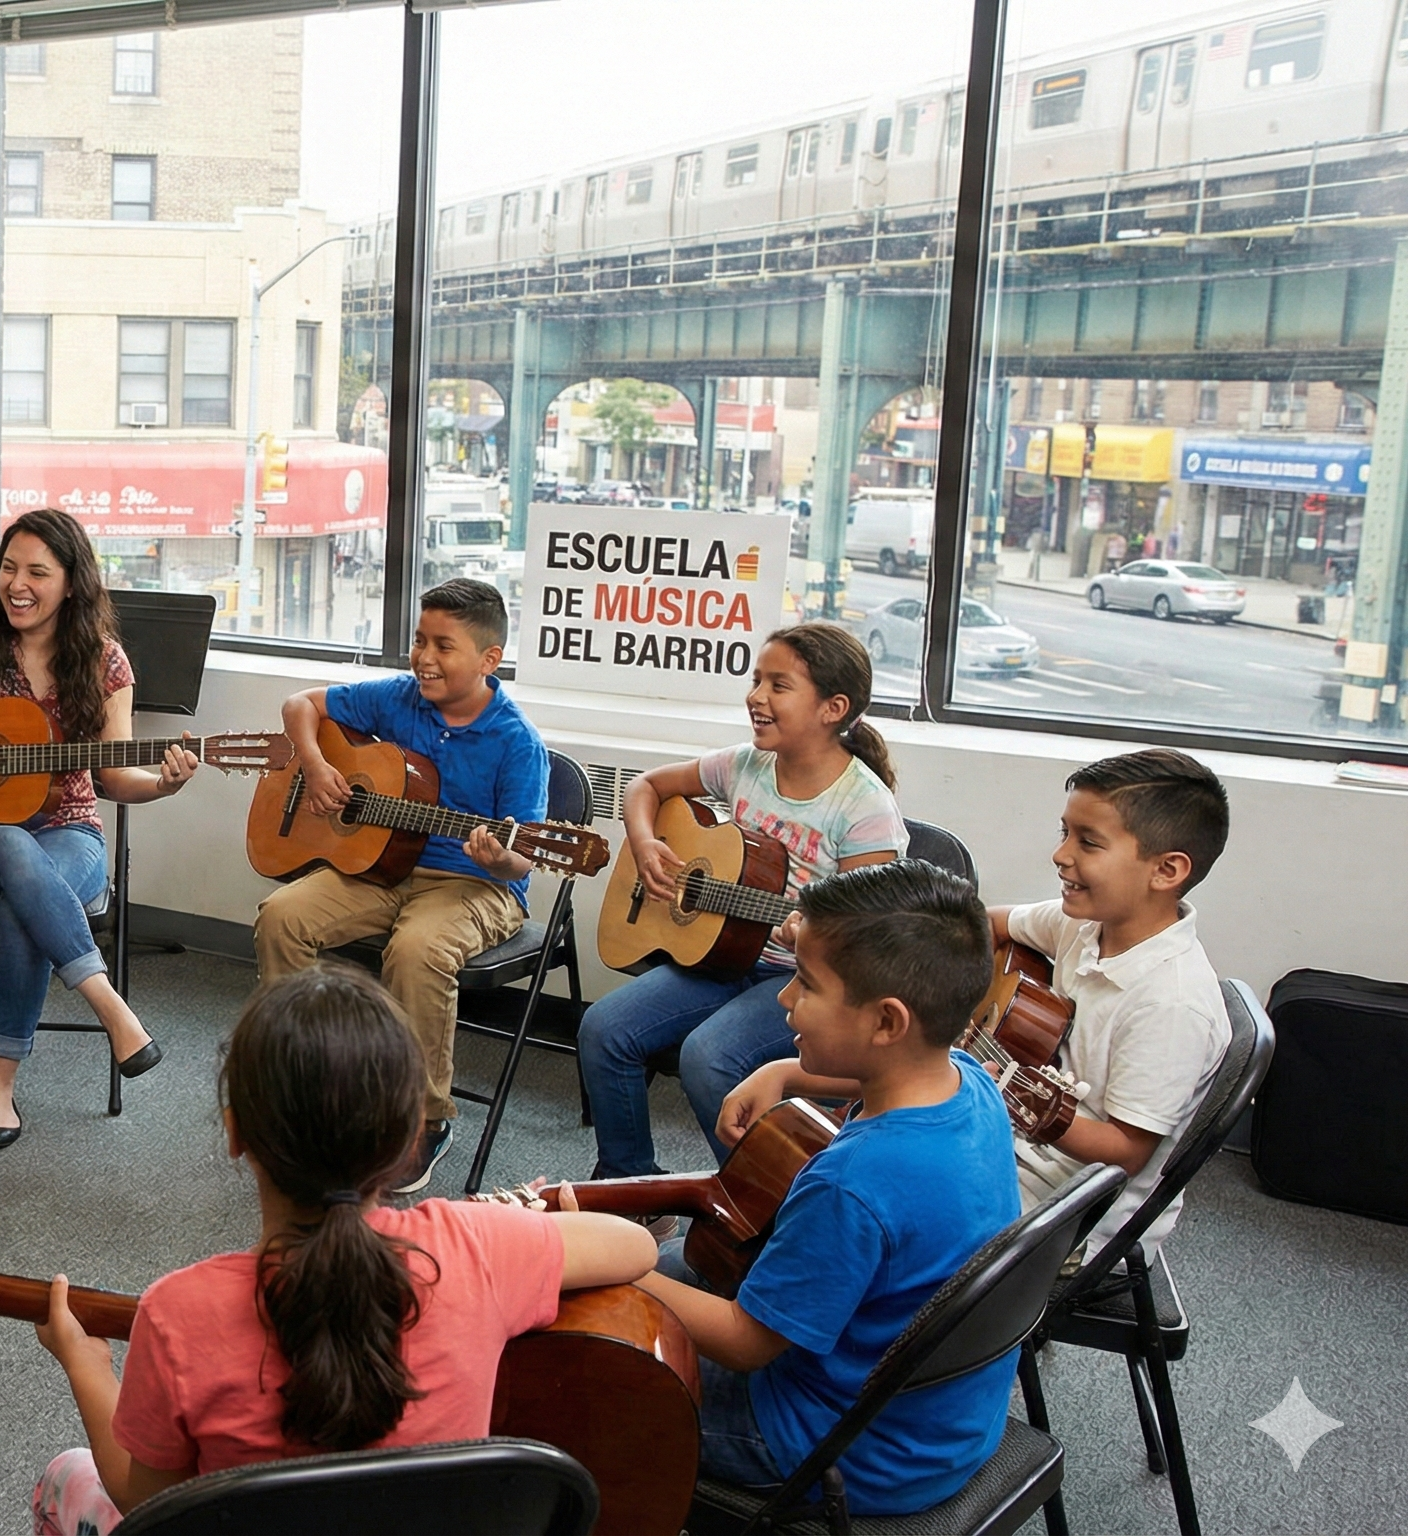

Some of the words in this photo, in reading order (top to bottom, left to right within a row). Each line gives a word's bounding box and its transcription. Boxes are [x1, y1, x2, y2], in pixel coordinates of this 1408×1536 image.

[546, 531, 731, 580] ESCUELA
[542, 586, 584, 619] DE
[594, 577, 753, 632] MÚSICA
[538, 625, 602, 663] DEL
[613, 631, 751, 677] BARRIO
